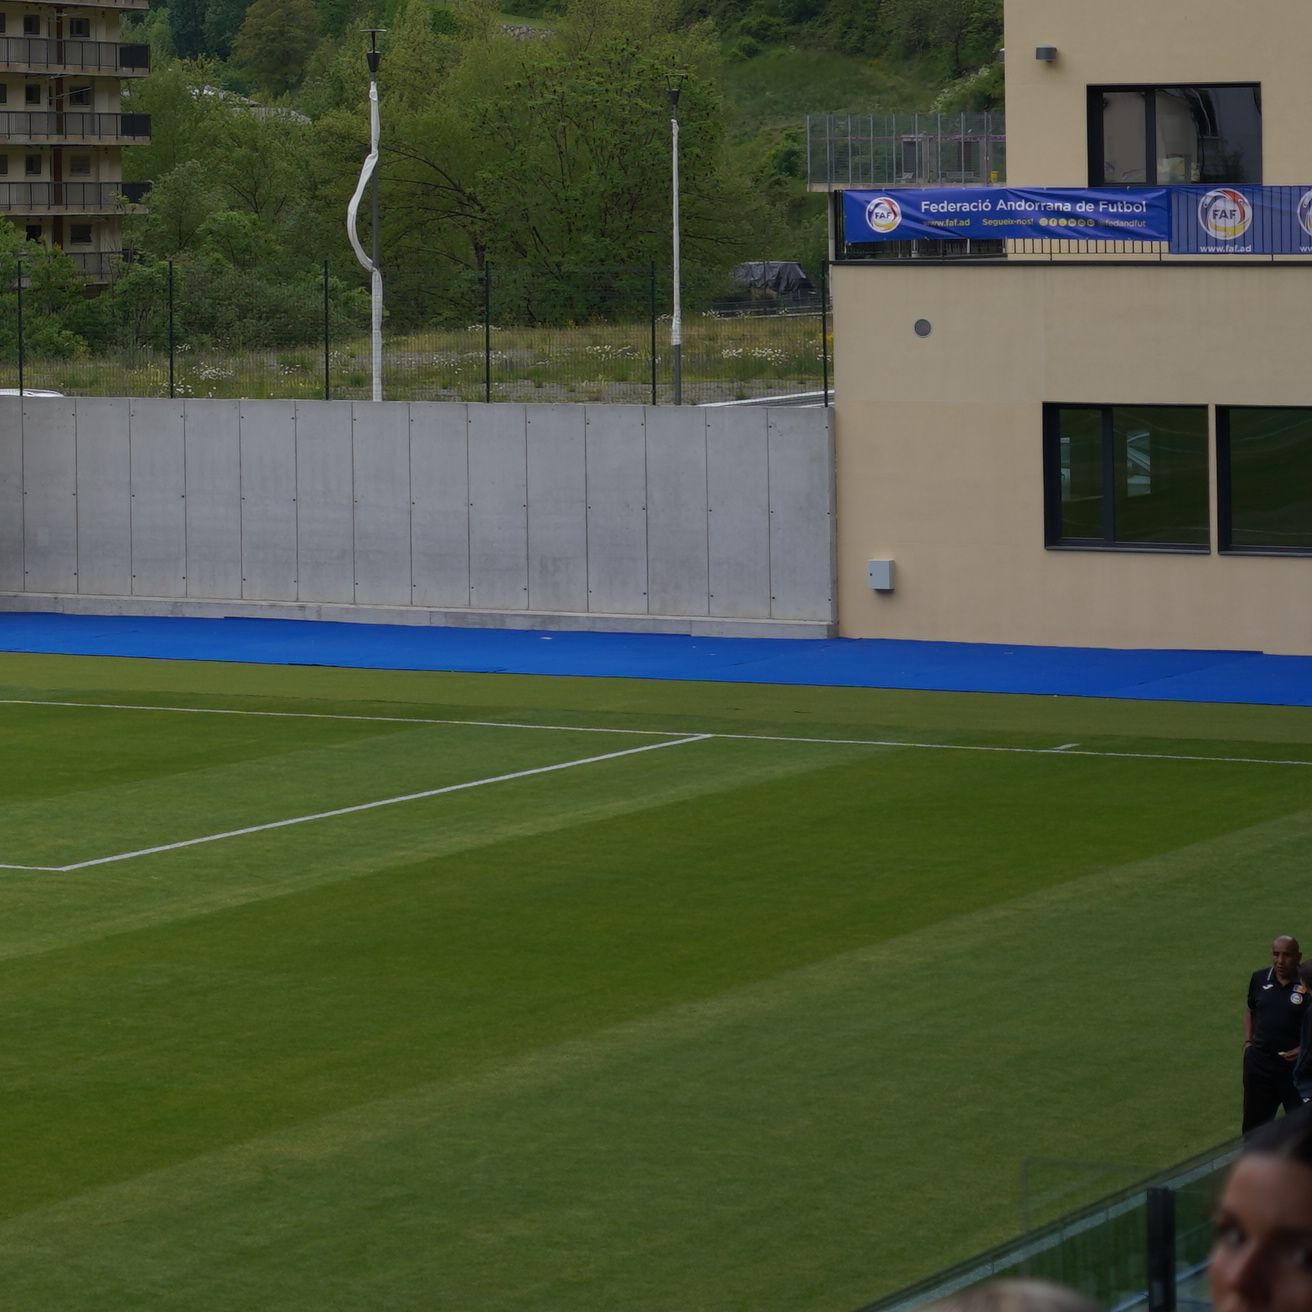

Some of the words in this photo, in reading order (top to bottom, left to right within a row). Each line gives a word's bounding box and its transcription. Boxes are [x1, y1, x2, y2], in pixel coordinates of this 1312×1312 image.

[921, 199, 992, 213] Federació
[996, 199, 1072, 212] Andorrana
[1076, 200, 1095, 212] de
[1099, 200, 1147, 213] Futbol
[874, 211, 892, 220] FAF
[1212, 209, 1237, 220] FAF
[1199, 244, 1252, 253] www.faf.ad
